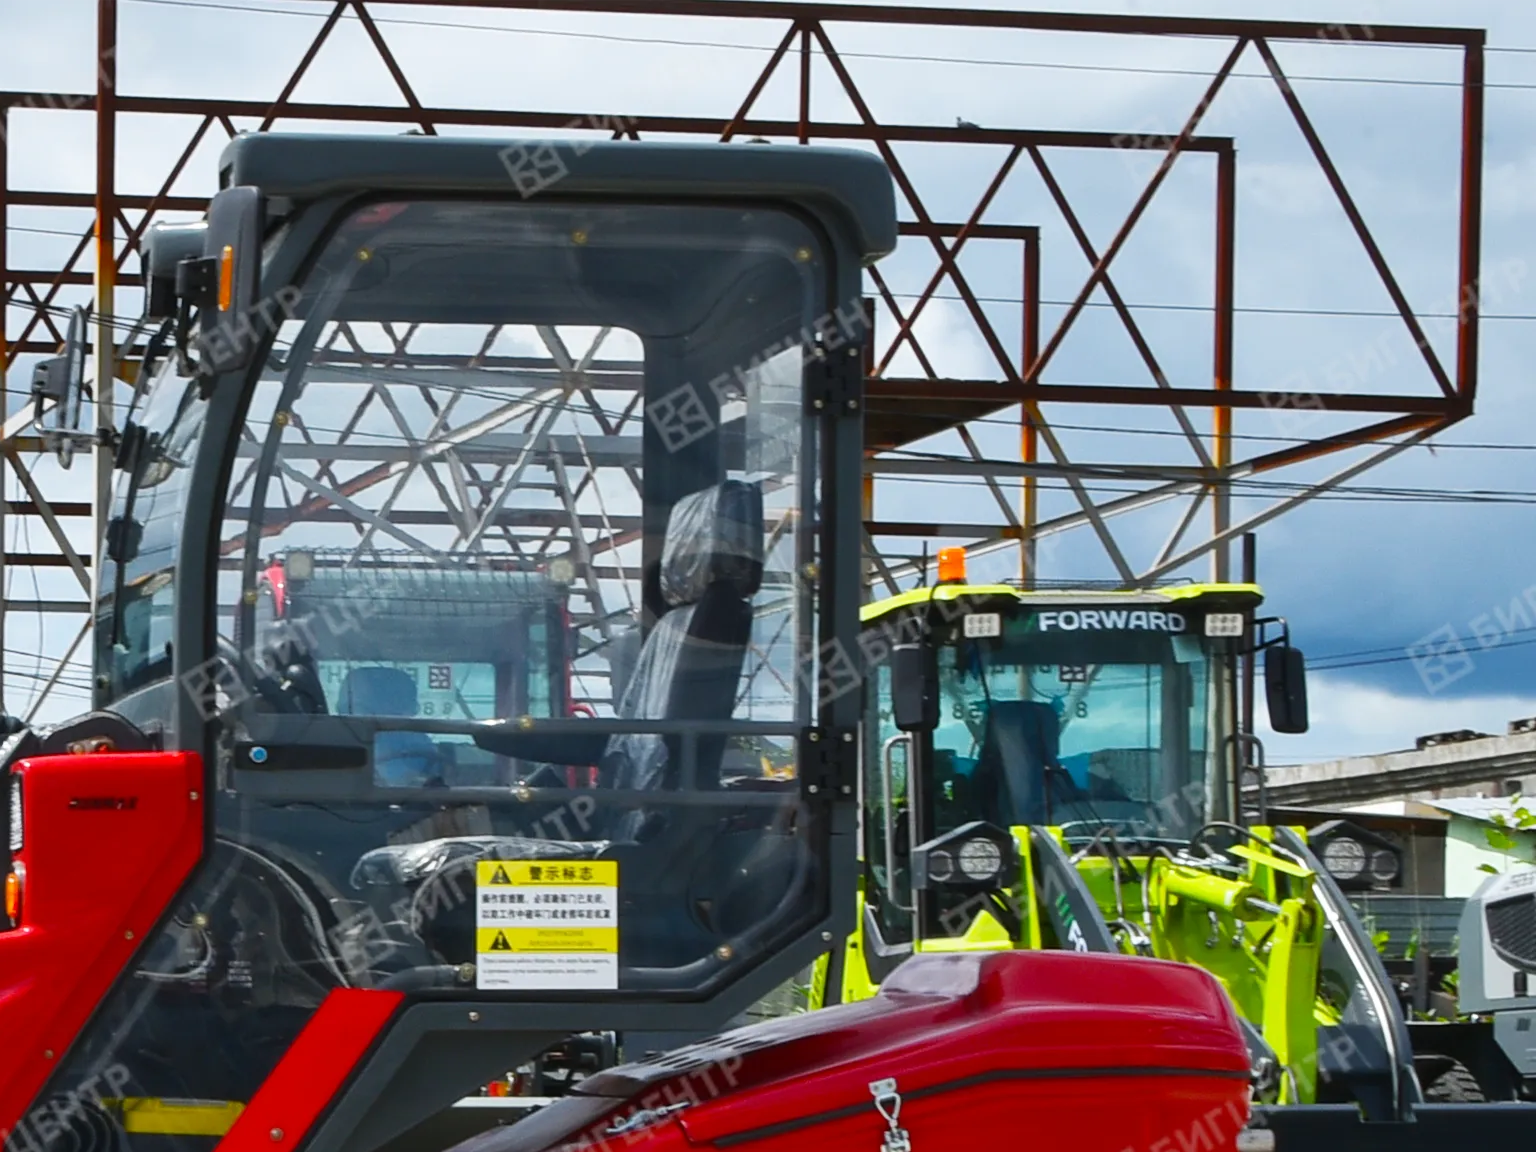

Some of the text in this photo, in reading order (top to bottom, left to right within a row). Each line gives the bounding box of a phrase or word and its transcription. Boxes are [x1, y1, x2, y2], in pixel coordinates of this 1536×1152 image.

[1038, 610, 1186, 632] FORWARD
[529, 866, 593, 881] 警示标志
